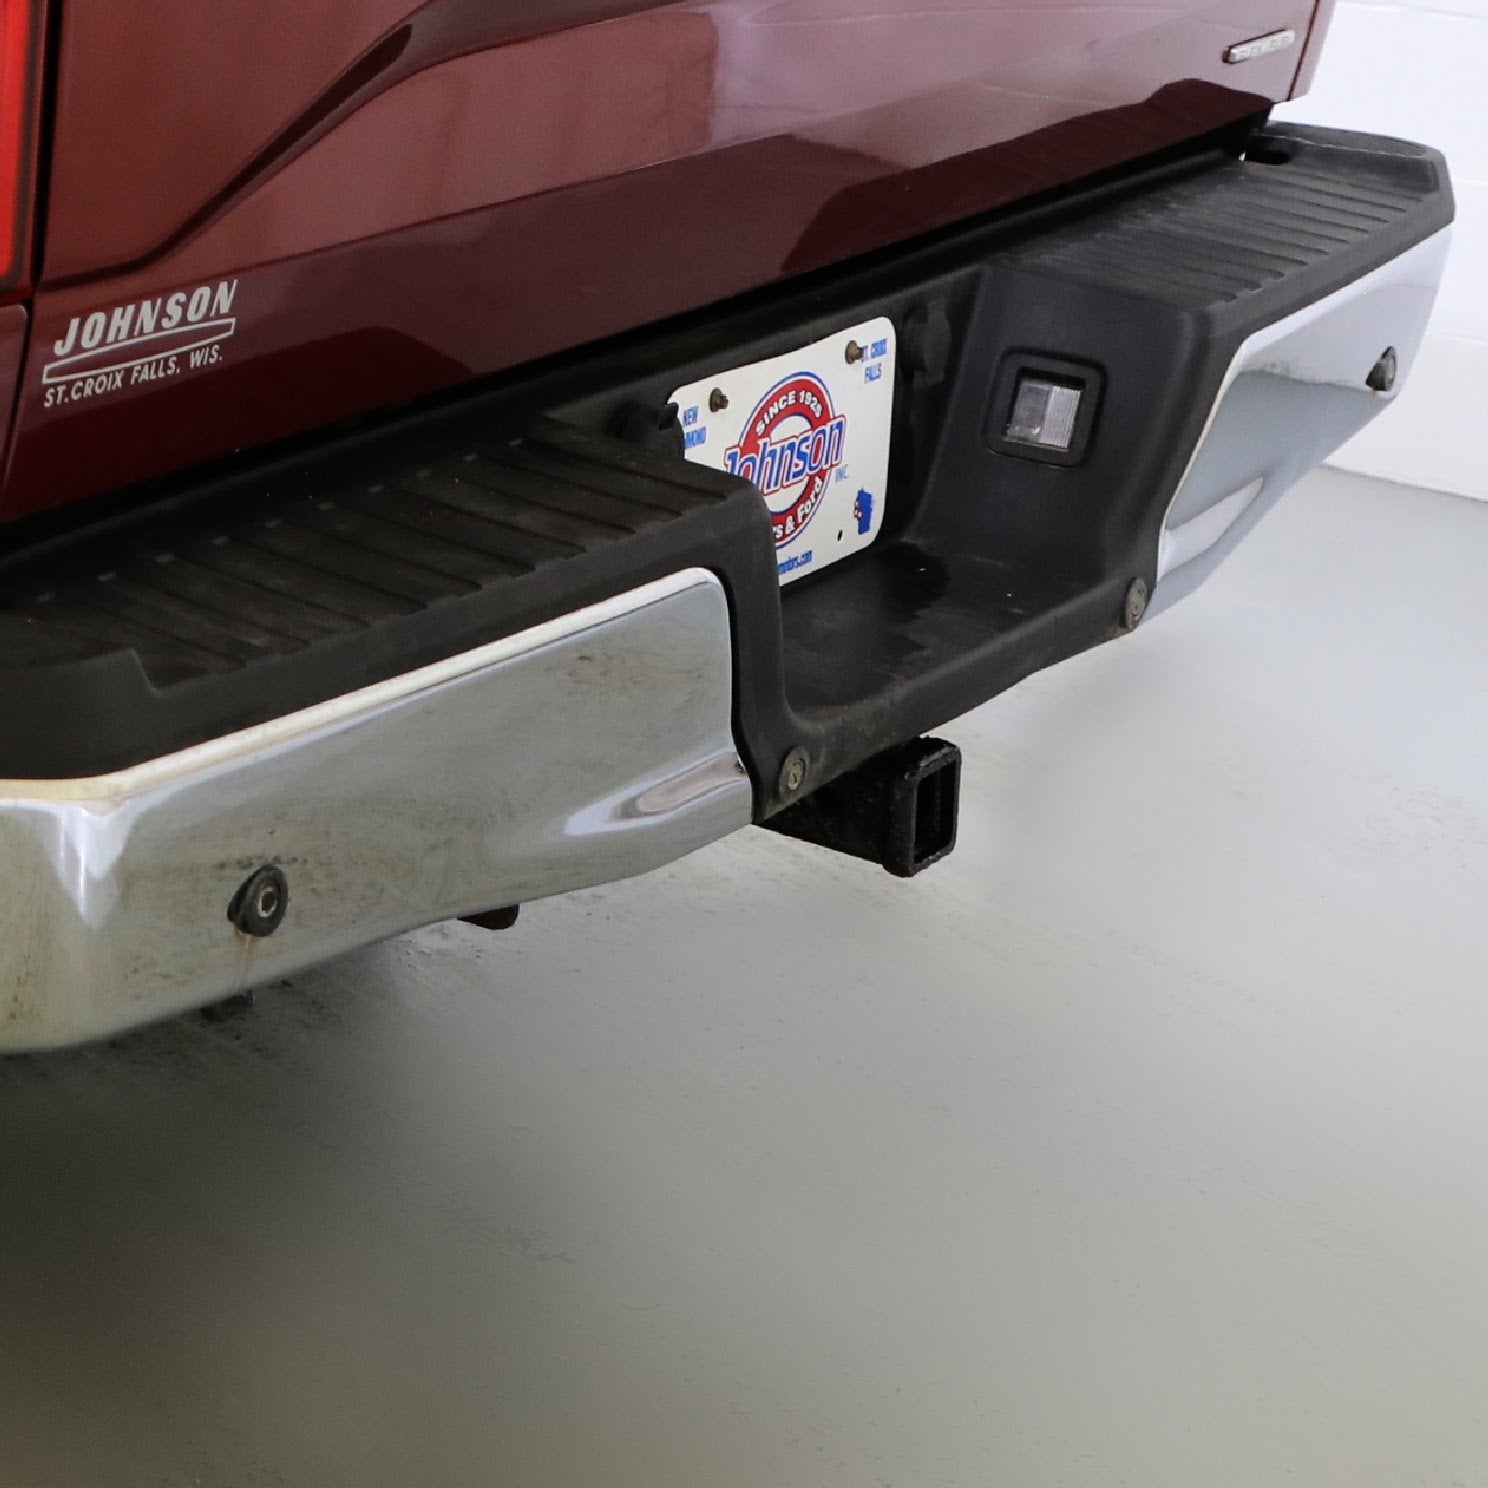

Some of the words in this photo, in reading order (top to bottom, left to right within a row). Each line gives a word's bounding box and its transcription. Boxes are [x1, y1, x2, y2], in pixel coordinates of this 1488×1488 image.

[53, 279, 239, 356] JOHNSON
[189, 345, 223, 370] WIS.
[756, 390, 796, 436] SINCE
